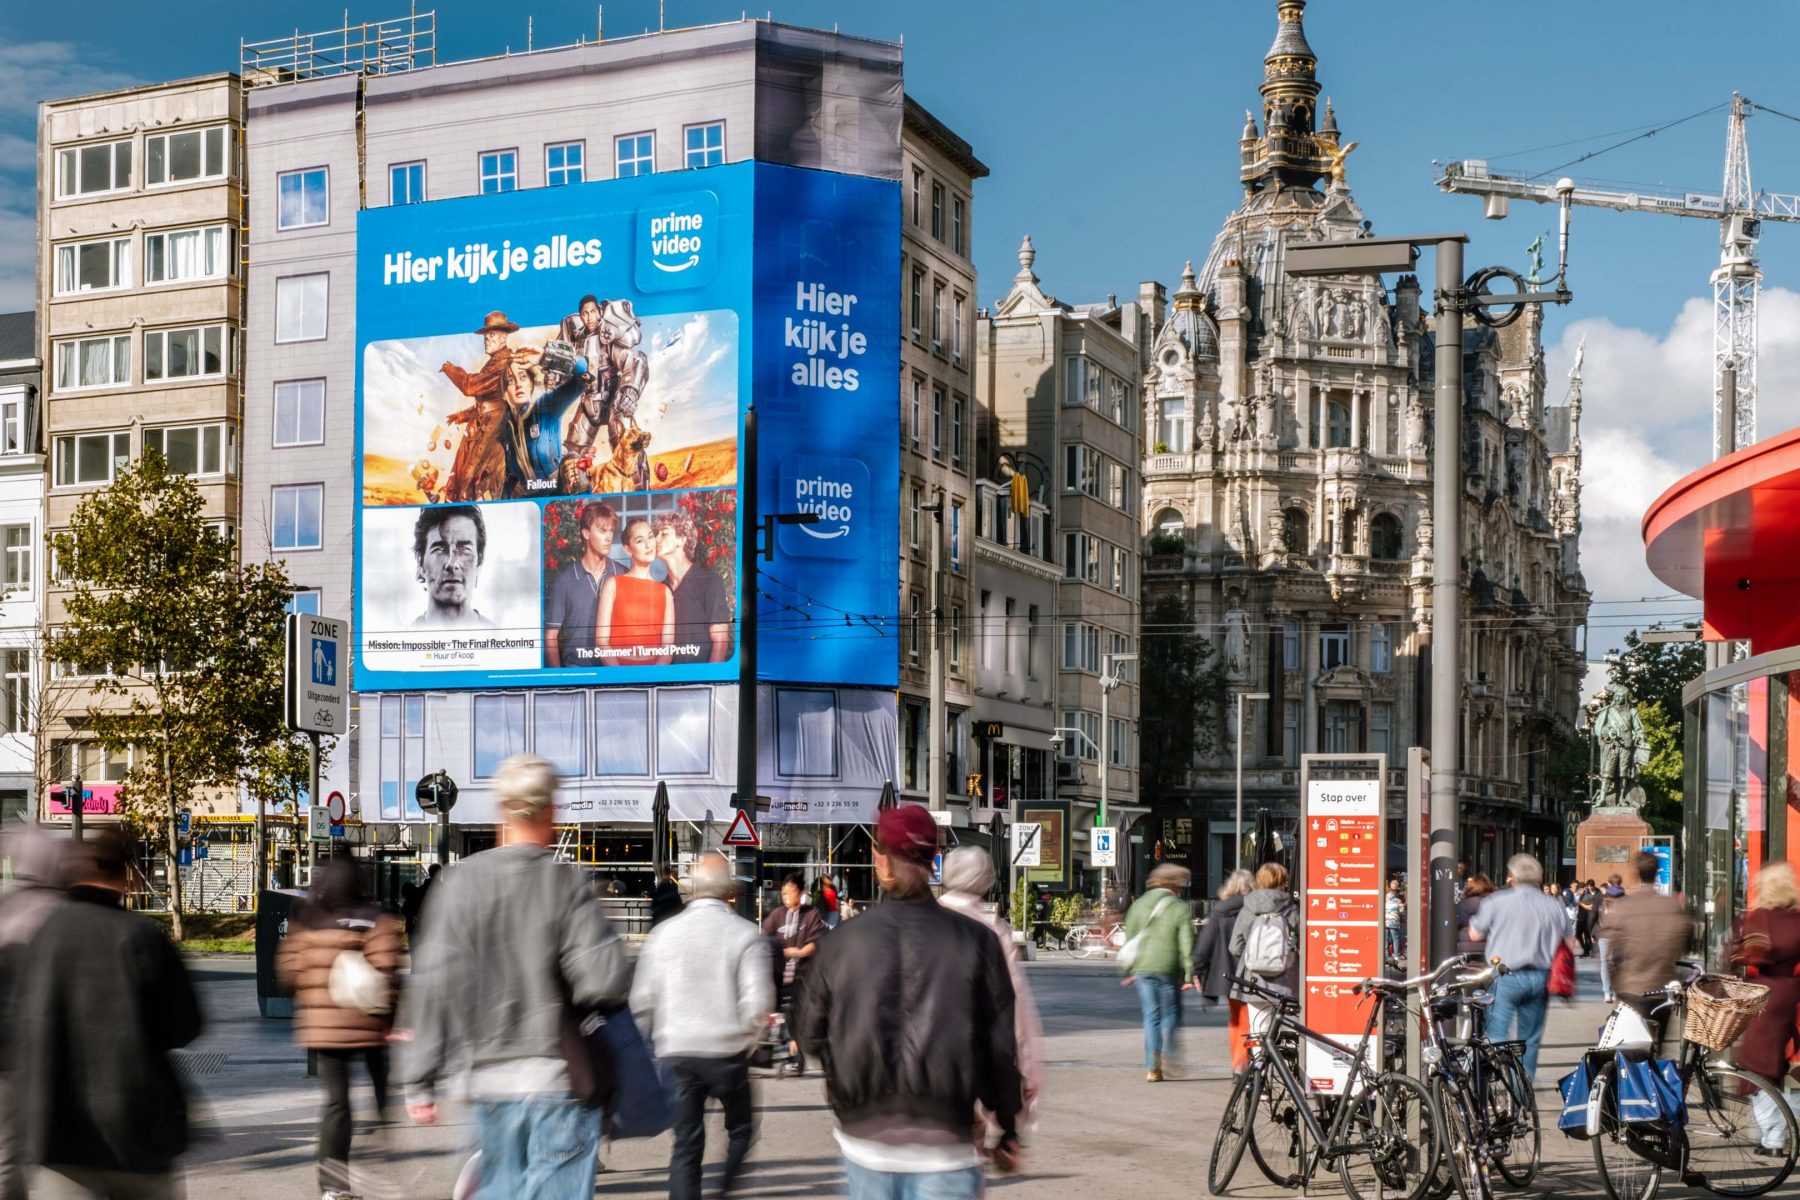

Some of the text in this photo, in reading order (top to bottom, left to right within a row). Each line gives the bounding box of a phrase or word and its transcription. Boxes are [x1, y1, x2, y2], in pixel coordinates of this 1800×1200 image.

[1702, 200, 1720, 208] BESIX
[651, 211, 703, 238] prime
[651, 233, 702, 256] video
[384, 234, 602, 286] Hier kijk je alles
[796, 281, 859, 317] Hier
[785, 317, 867, 360] kijk je
[792, 358, 859, 392] alles
[526, 478, 558, 490] Fallout
[796, 475, 853, 500] prime
[797, 498, 852, 522] video
[310, 620, 339, 640] ZONE
[368, 640, 401, 650] Mission:
[401, 640, 446, 651] Impossible
[451, 639, 468, 649] The
[468, 639, 489, 648] Final
[490, 637, 535, 649] Reckoning
[576, 648, 594, 659] The
[594, 646, 633, 658] Summer
[637, 645, 669, 657] Turned
[669, 643, 701, 656] Pretty
[433, 652, 450, 660] Huur
[458, 651, 475, 660] koop
[307, 690, 341, 705] Uitgezonderd
[571, 801, 592, 810] media
[784, 802, 807, 811] media
[1345, 794, 1367, 803] over
